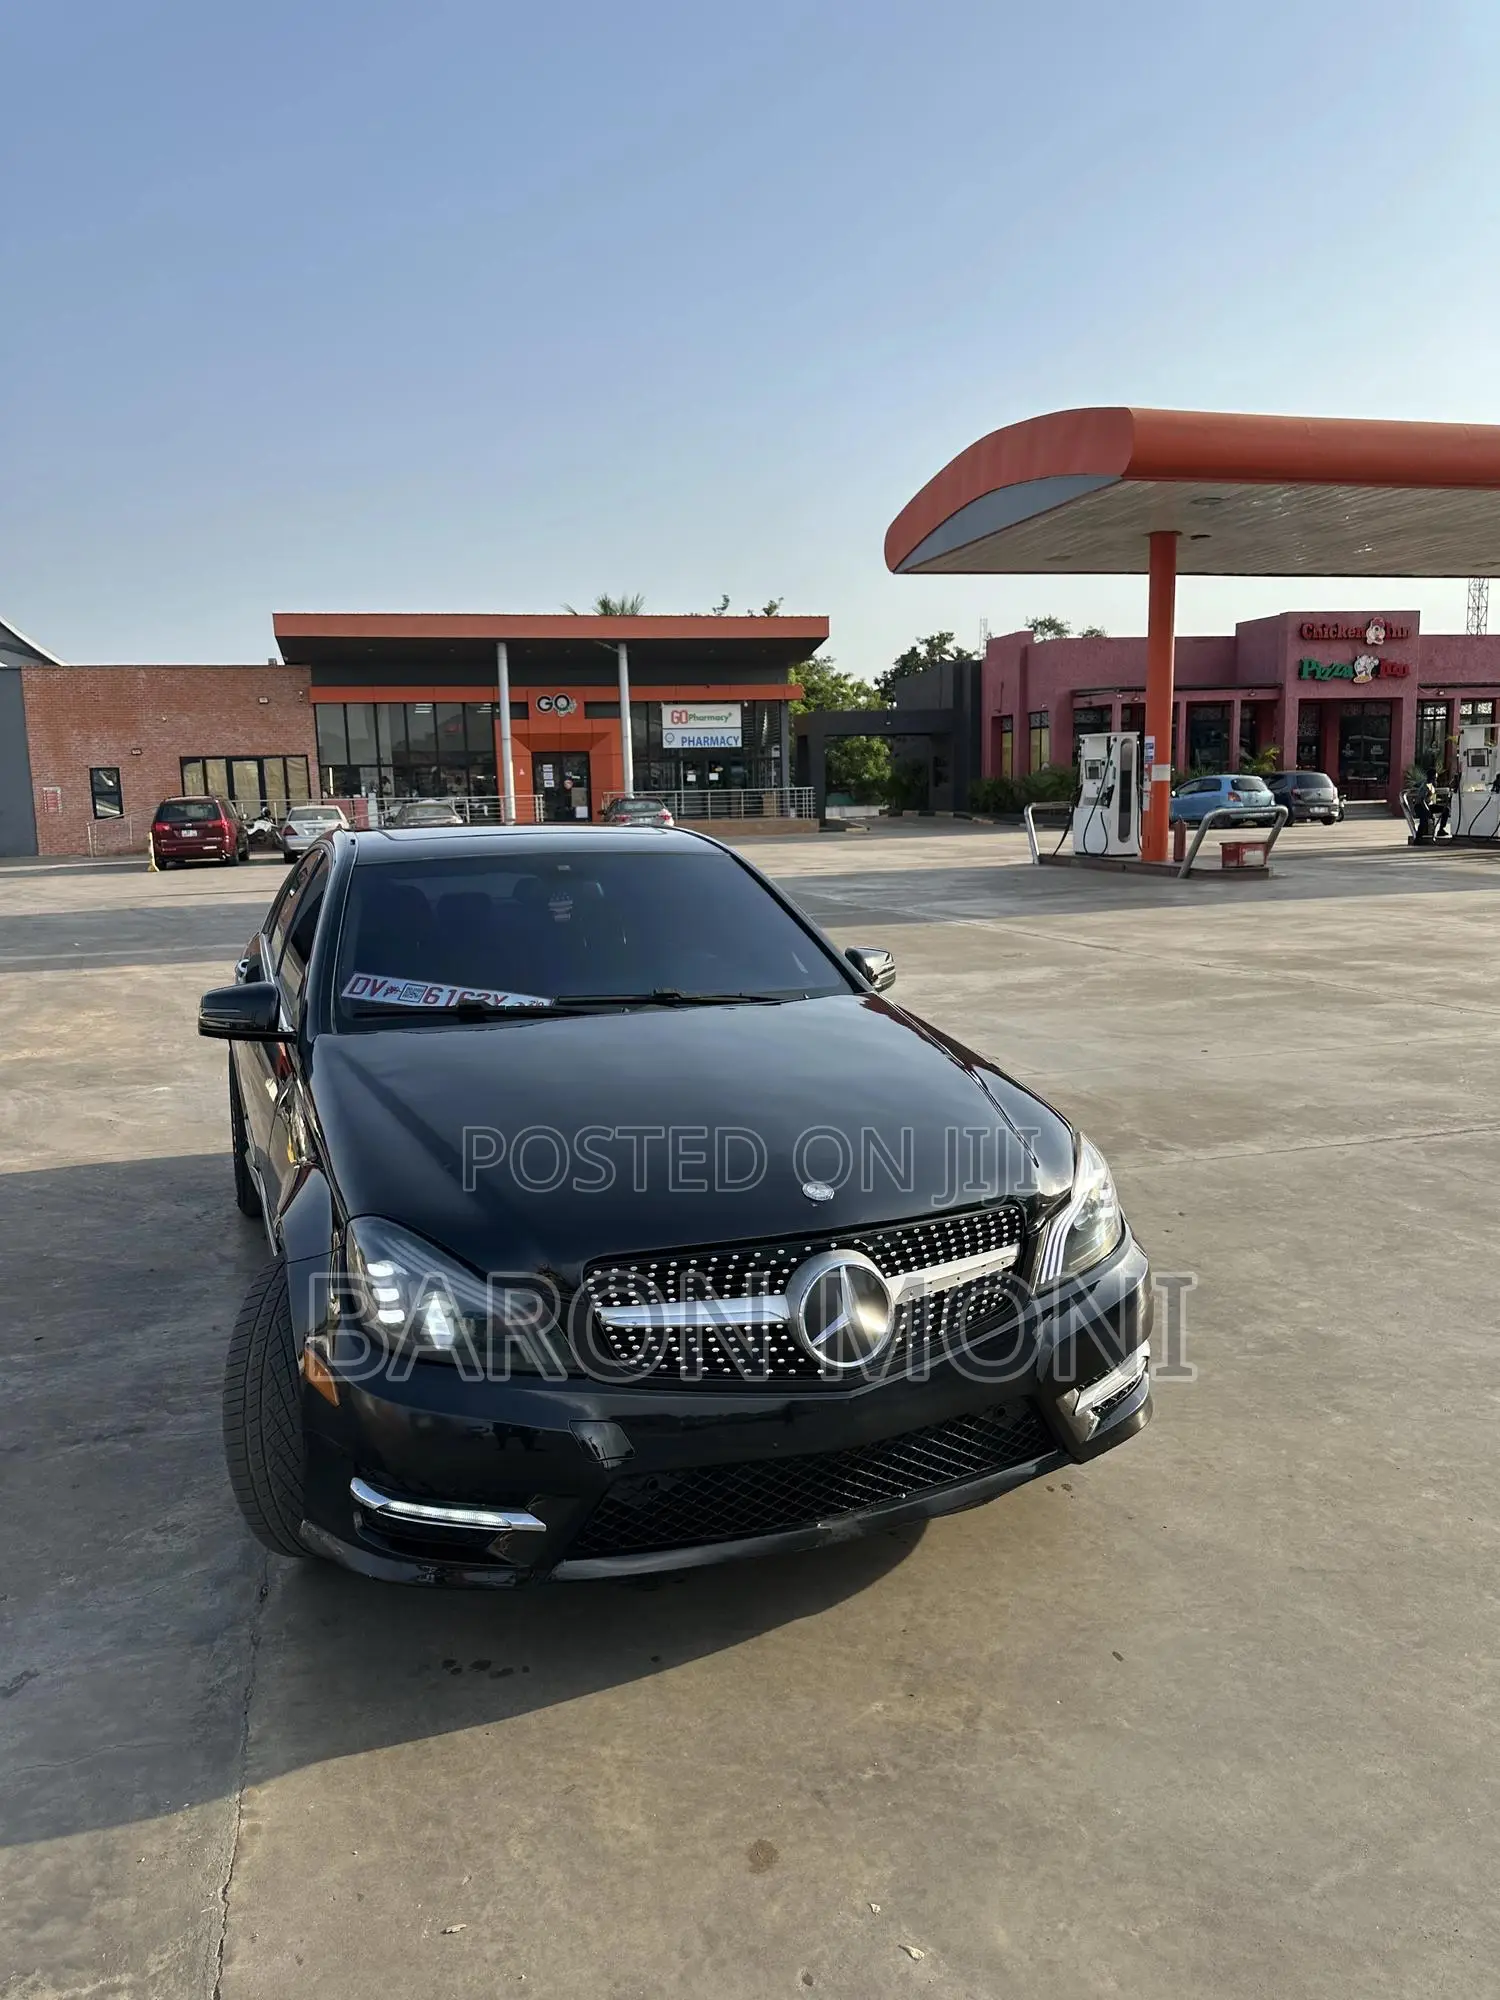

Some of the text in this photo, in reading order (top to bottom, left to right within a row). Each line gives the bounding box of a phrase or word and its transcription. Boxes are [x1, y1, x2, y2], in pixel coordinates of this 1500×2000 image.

[1300, 622, 1411, 641] Chicken Inn
[1299, 657, 1354, 681] Pizza
[536, 693, 571, 713] GO
[681, 735, 740, 747] PHARMACY
[347, 976, 388, 997] DV
